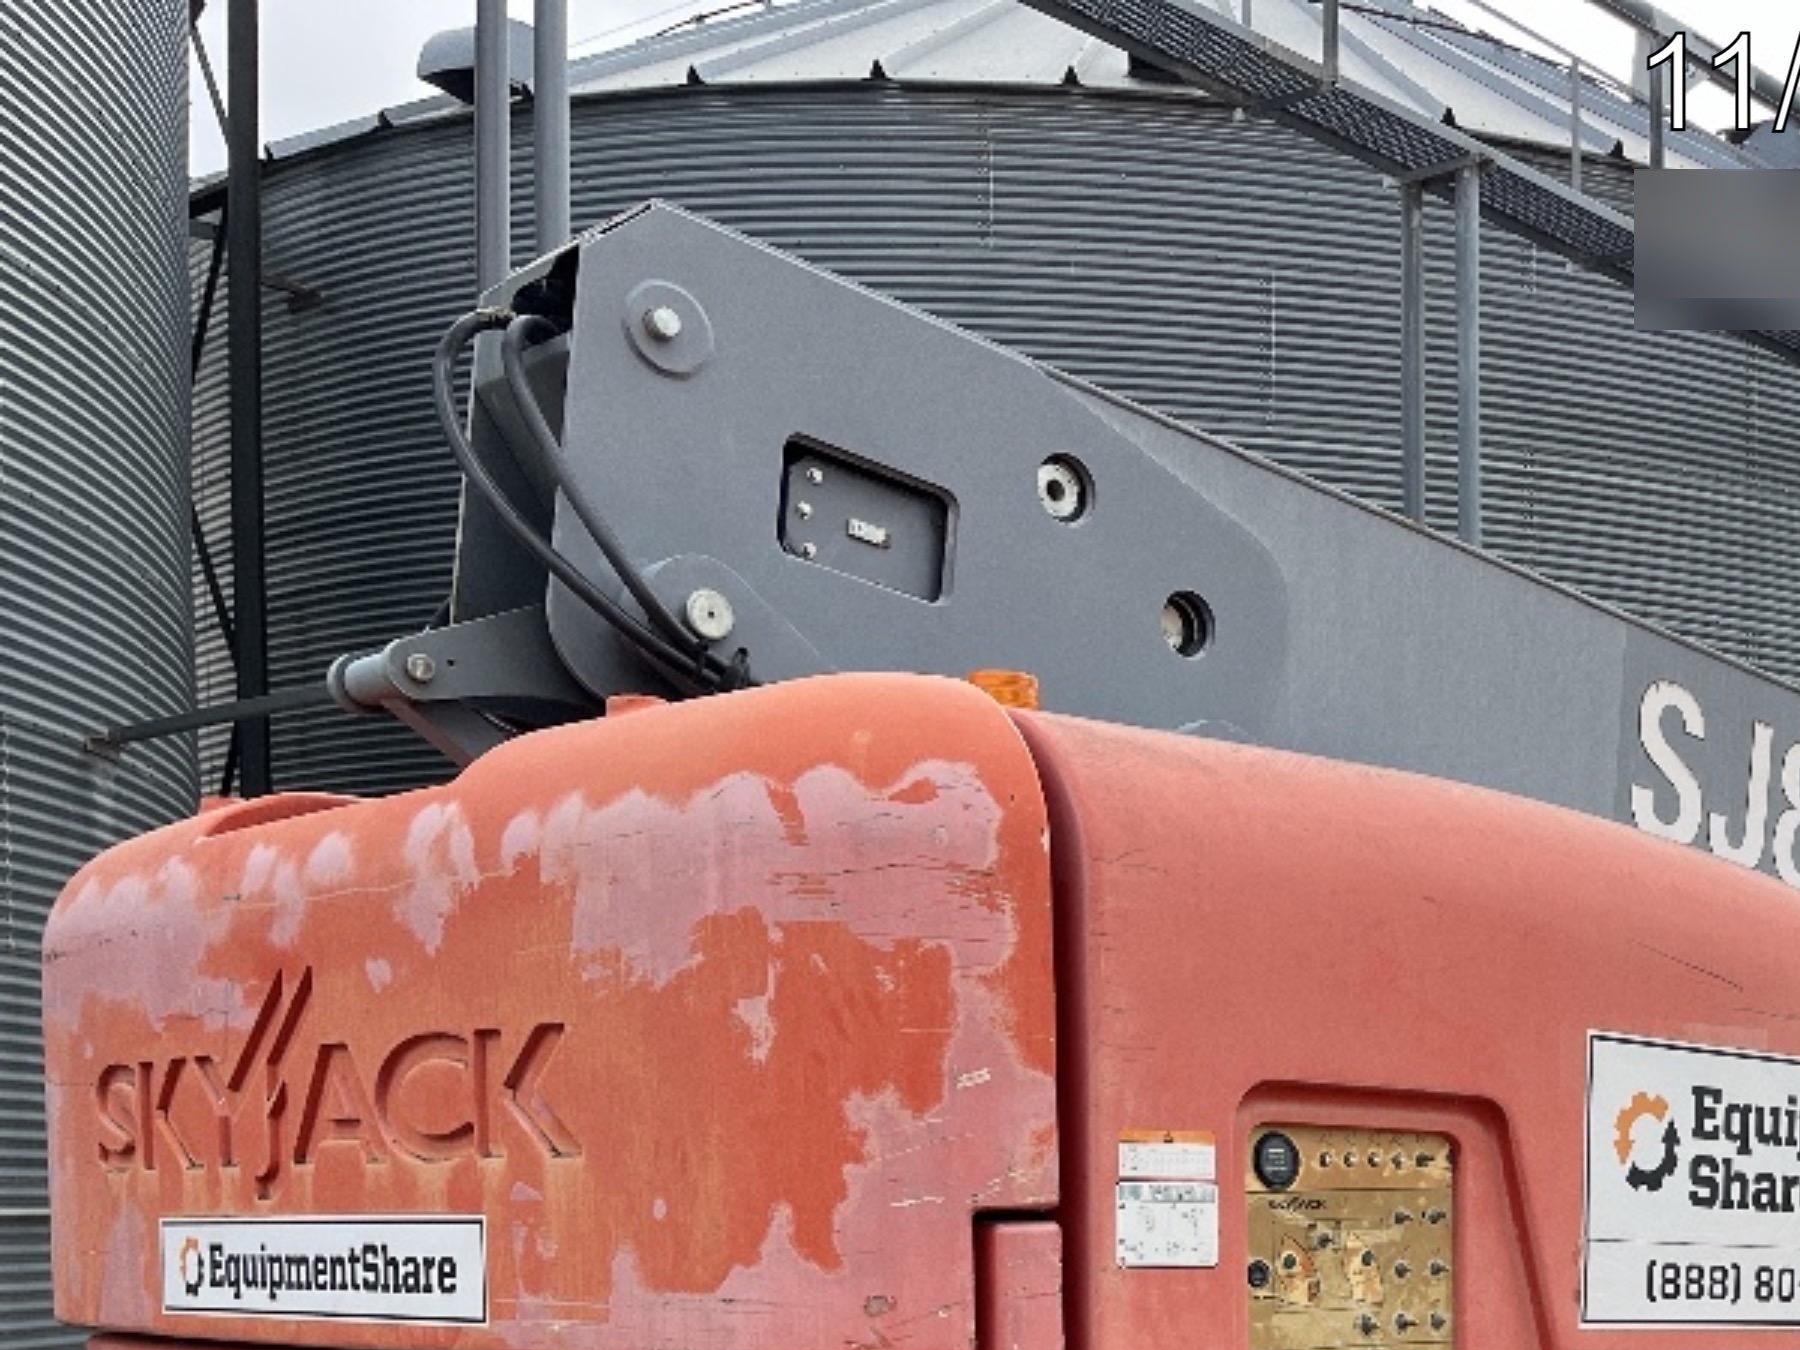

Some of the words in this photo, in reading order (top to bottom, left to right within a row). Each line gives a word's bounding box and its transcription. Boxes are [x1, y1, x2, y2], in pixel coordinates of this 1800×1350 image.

[94, 965, 585, 1200] SKYJACK
[208, 1242, 458, 1303] EquipmentShare
[1646, 1258, 1742, 1305] (888)
